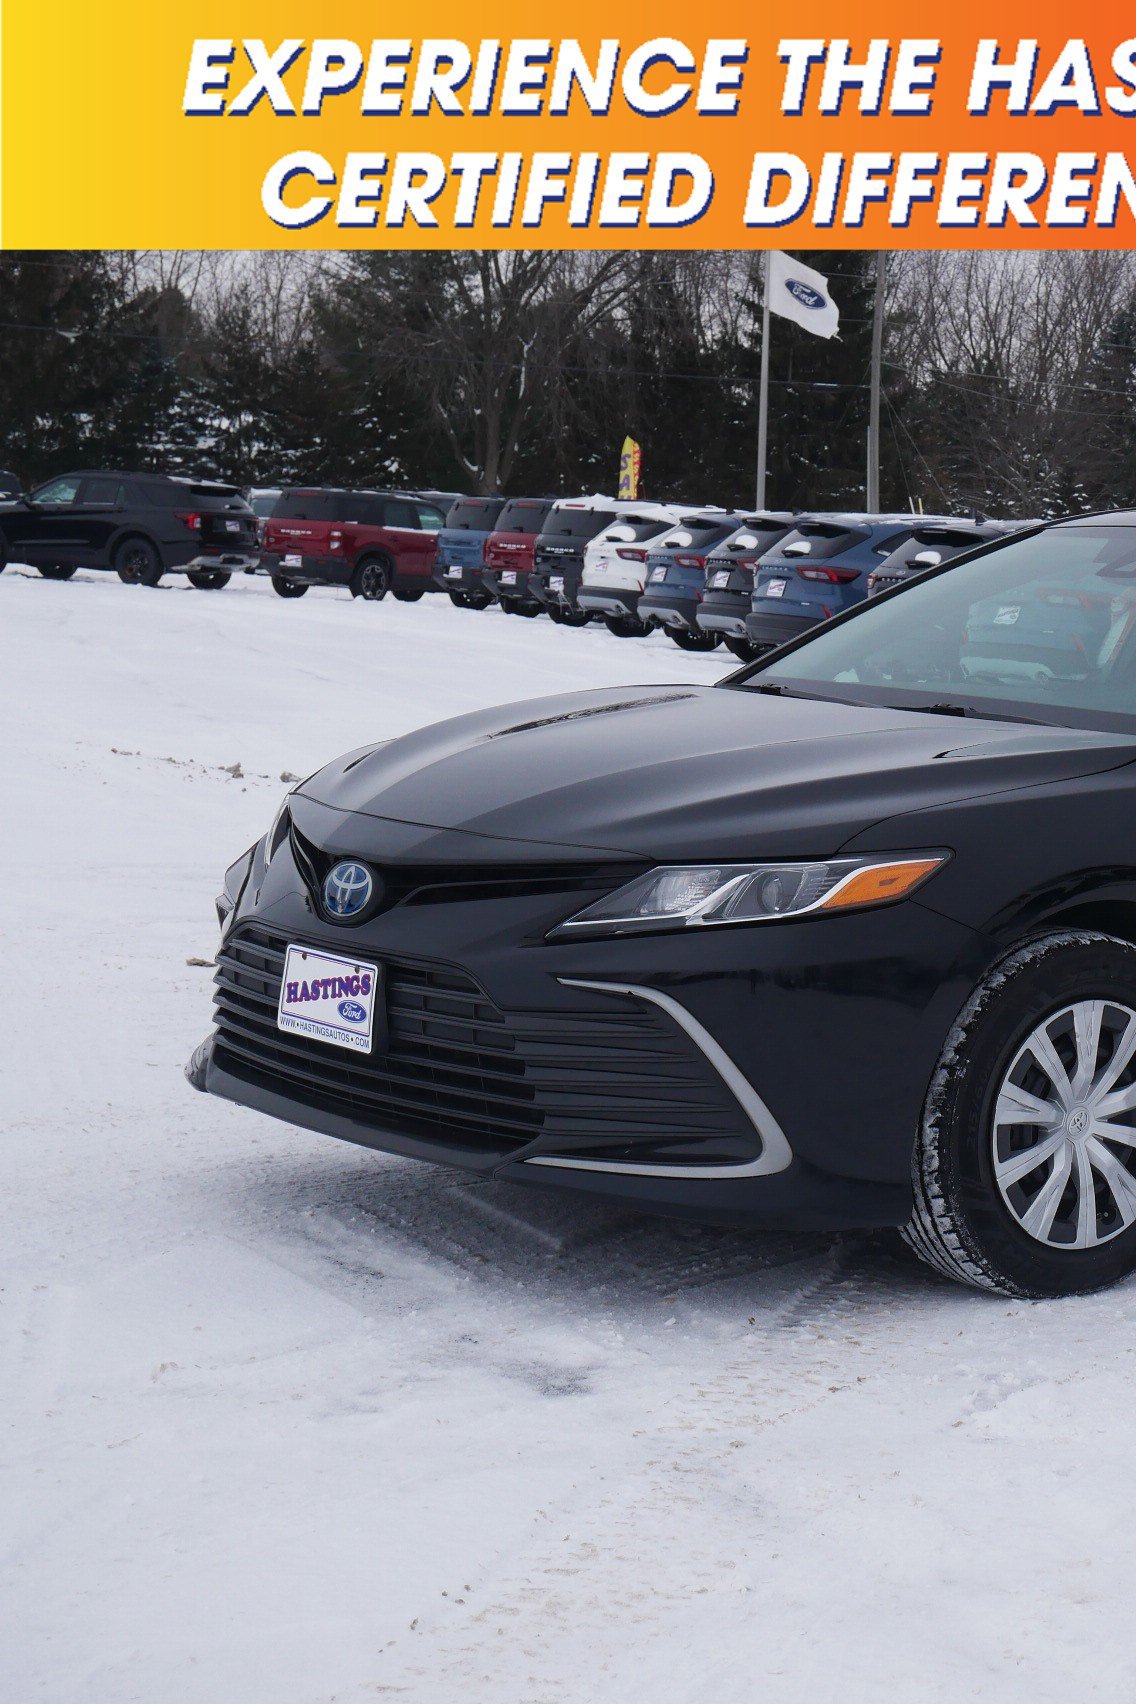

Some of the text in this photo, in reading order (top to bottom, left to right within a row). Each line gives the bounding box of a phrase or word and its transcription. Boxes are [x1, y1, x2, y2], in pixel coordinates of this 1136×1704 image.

[793, 283, 818, 305] Ford
[286, 973, 371, 1003] HASTINGS
[342, 1002, 363, 1020] Ford
